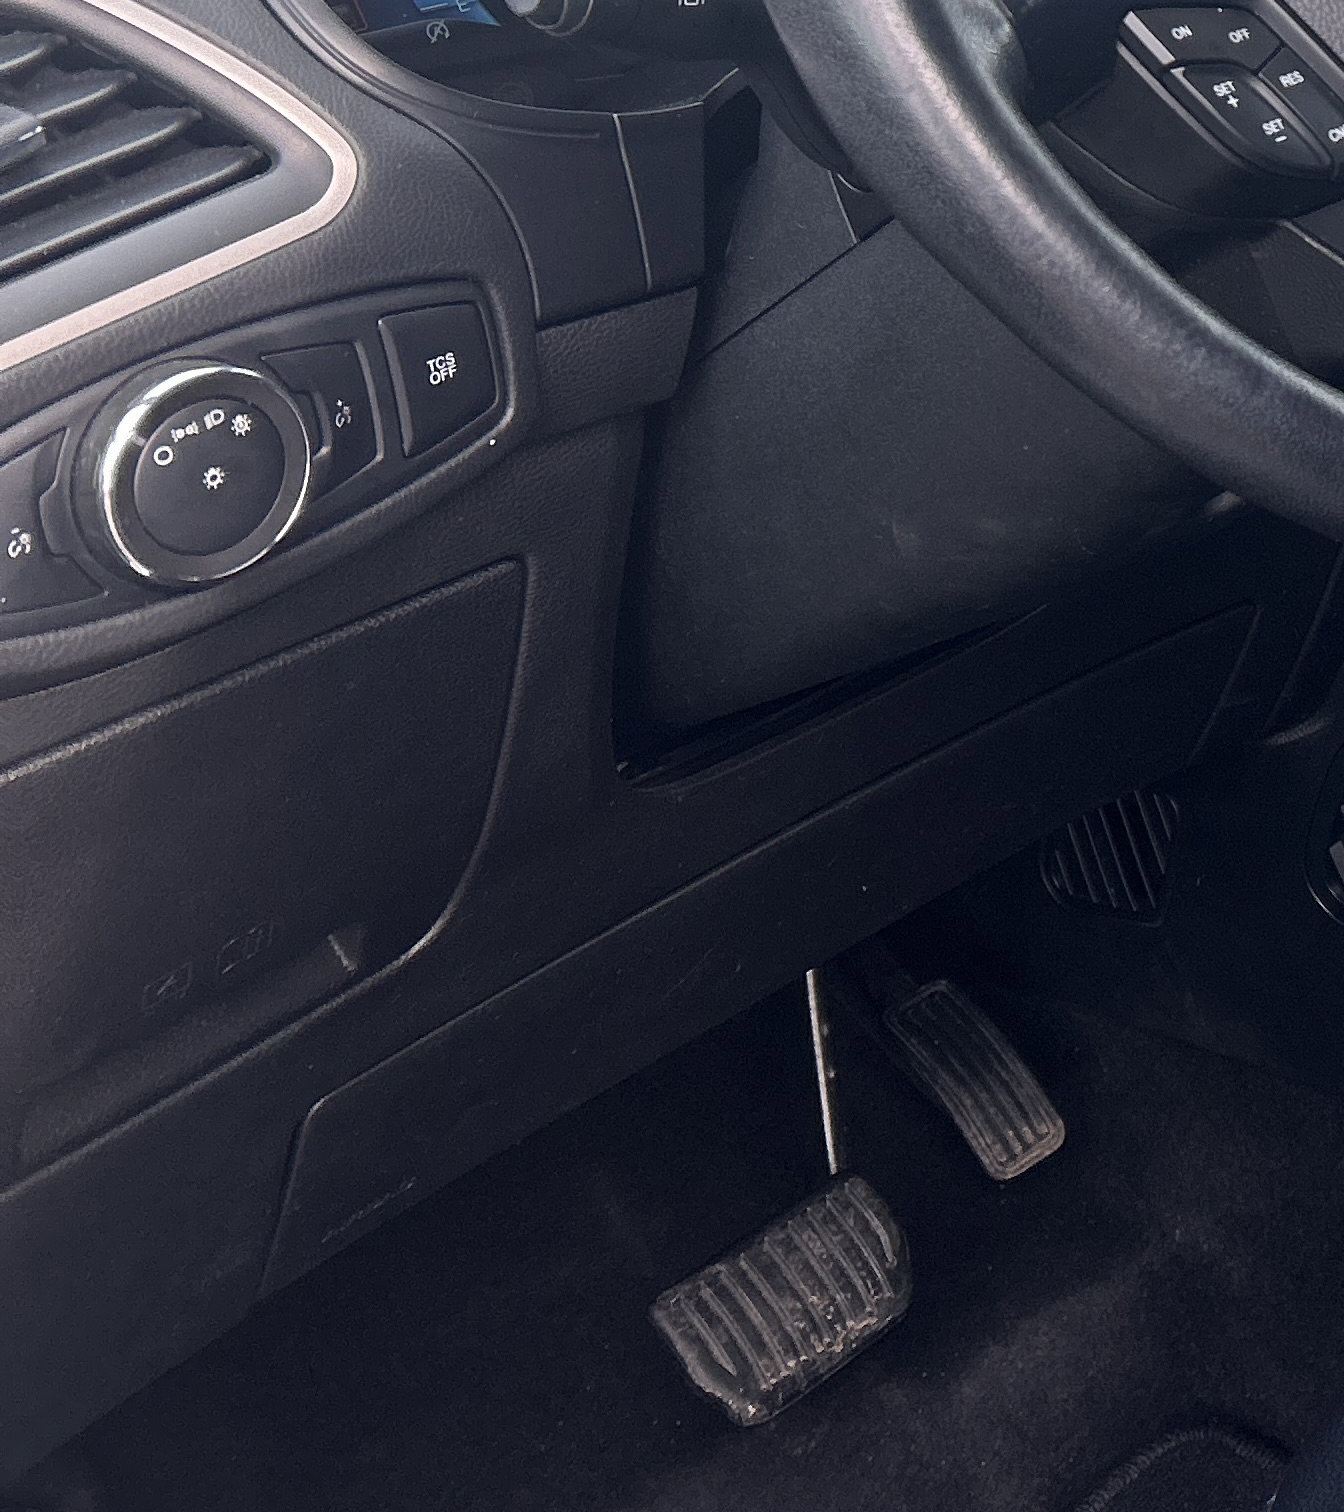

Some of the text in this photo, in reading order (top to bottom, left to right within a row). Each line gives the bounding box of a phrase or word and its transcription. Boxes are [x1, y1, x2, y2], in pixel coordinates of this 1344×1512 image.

[1170, 24, 1193, 40] ON
[1228, 27, 1251, 44] OFF
[1278, 70, 1305, 88] RES
[1212, 80, 1237, 97] SET
[1262, 117, 1285, 136] SET
[426, 352, 456, 372] TCS
[430, 364, 457, 385] OFF
